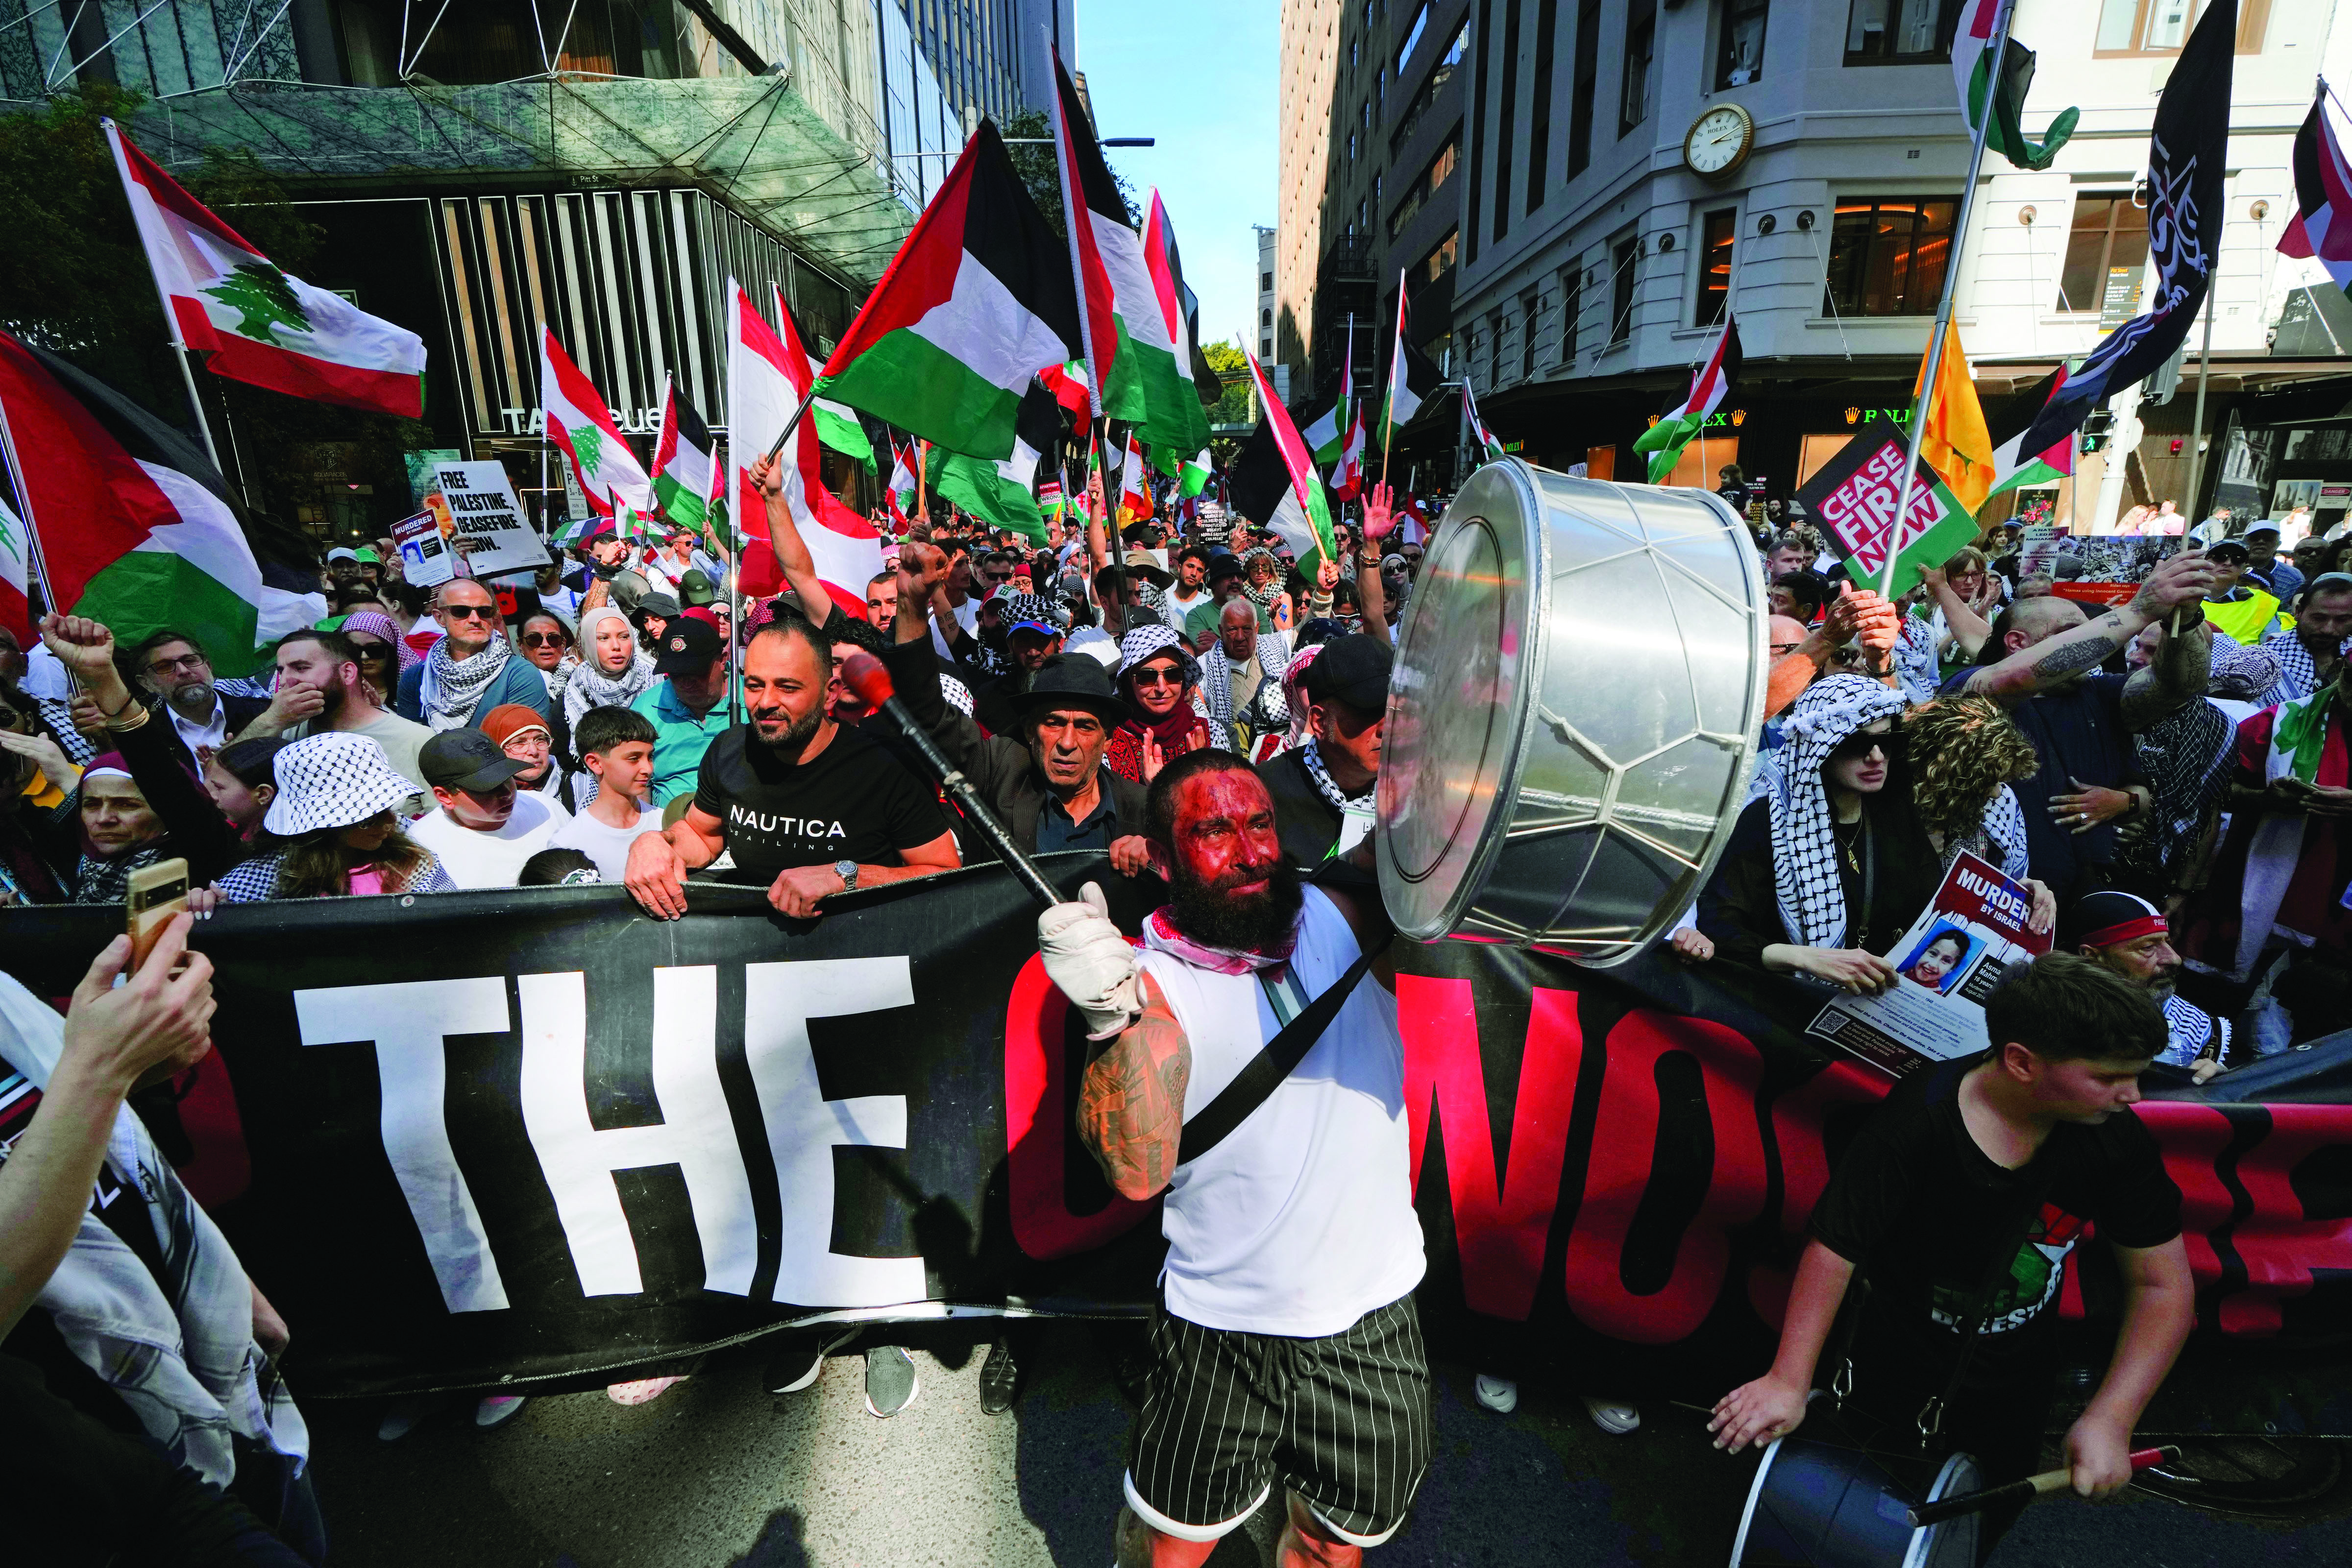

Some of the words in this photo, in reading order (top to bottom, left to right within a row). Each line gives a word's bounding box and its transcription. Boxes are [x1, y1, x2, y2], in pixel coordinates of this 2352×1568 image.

[1708, 125, 1727, 134] ROLEX
[502, 408, 542, 435] TA
[608, 408, 663, 433] eue
[1506, 442, 1520, 452] ROLEX
[440, 471, 469, 489] FREE
[567, 473, 572, 484] P
[1823, 445, 1903, 521] CEASE
[448, 492, 515, 511] PALESTINE,
[394, 515, 432, 535] MURDERED
[456, 514, 521, 533] CEASEFIRE
[730, 804, 846, 838] NAUTICA
[735, 830, 833, 851] SAILING
[1956, 868, 2047, 934] MURDER
[1981, 904, 1992, 915] BY
[1993, 909, 2022, 932] ISRAEL
[1978, 967, 1998, 982] Mahm
[1983, 961, 2002, 975] Asma
[1964, 987, 1977, 997] August
[1968, 982, 1985, 993] Murdered
[1979, 979, 1993, 990] years
[1904, 992, 1916, 1001] crimes
[1848, 1003, 1863, 1014] Spread
[1871, 1015, 1883, 1024] truth.
[1883, 1022, 1899, 1034] Change
[1907, 1035, 1927, 1048] narrative.
[1884, 1007, 1900, 1018] targeted
[1899, 1015, 1912, 1024] attacks
[1916, 1024, 1931, 1034] civilians
[1886, 1014, 1902, 1024] ruthless
[1908, 1025, 1920, 1035] bloody
[1924, 1017, 1943, 1030] systematic
[1851, 1022, 1875, 1037] Palestinians
[1885, 1040, 1896, 1050] every
[1895, 1046, 1907, 1056] right
[1851, 1034, 1863, 1043] every
[1862, 1039, 1873, 1048] right
[1877, 1048, 1890, 1057] resist.
[1871, 1038, 1895, 1054] Palestinians
[293, 955, 927, 1314] THE
